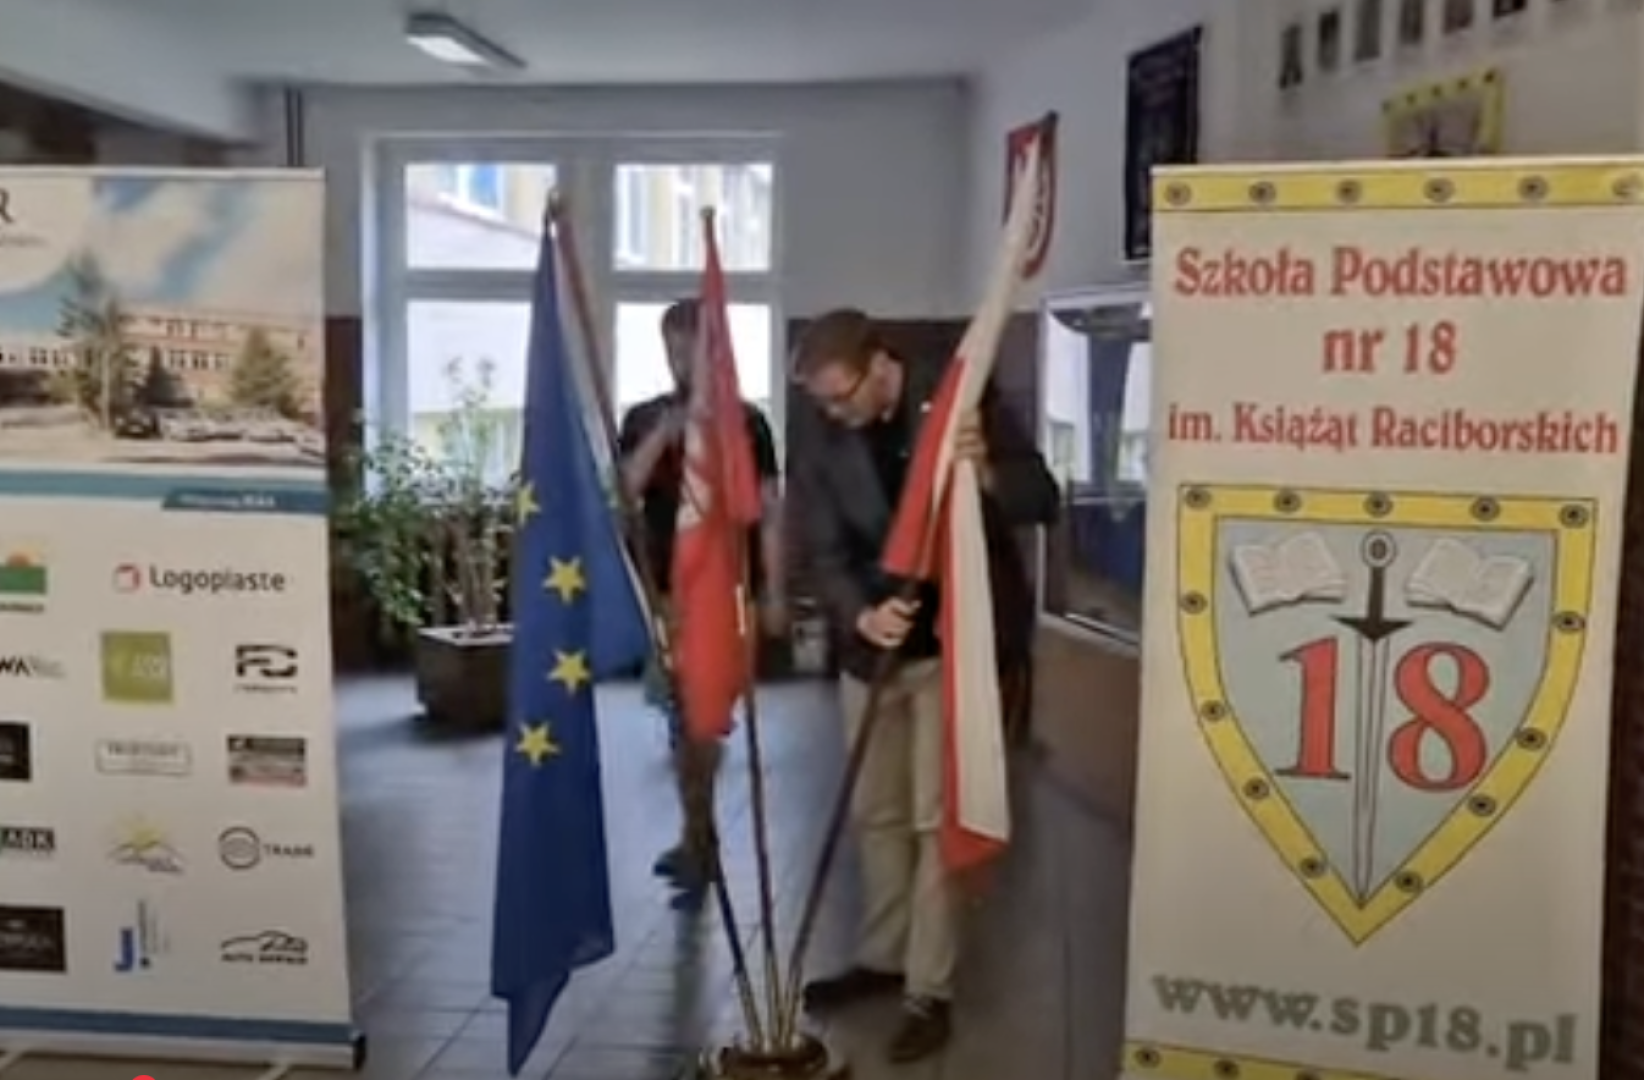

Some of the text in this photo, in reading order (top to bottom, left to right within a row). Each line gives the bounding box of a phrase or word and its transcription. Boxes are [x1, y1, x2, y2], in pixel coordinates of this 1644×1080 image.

[1174, 246, 1628, 297] Szkoła Podstawowa
[1323, 321, 1457, 375] nr 18
[1169, 402, 1619, 455] im. Książąt Raciborskich
[149, 564, 287, 595] Logoplaste
[1151, 974, 1578, 1070] www.sp18.pl
